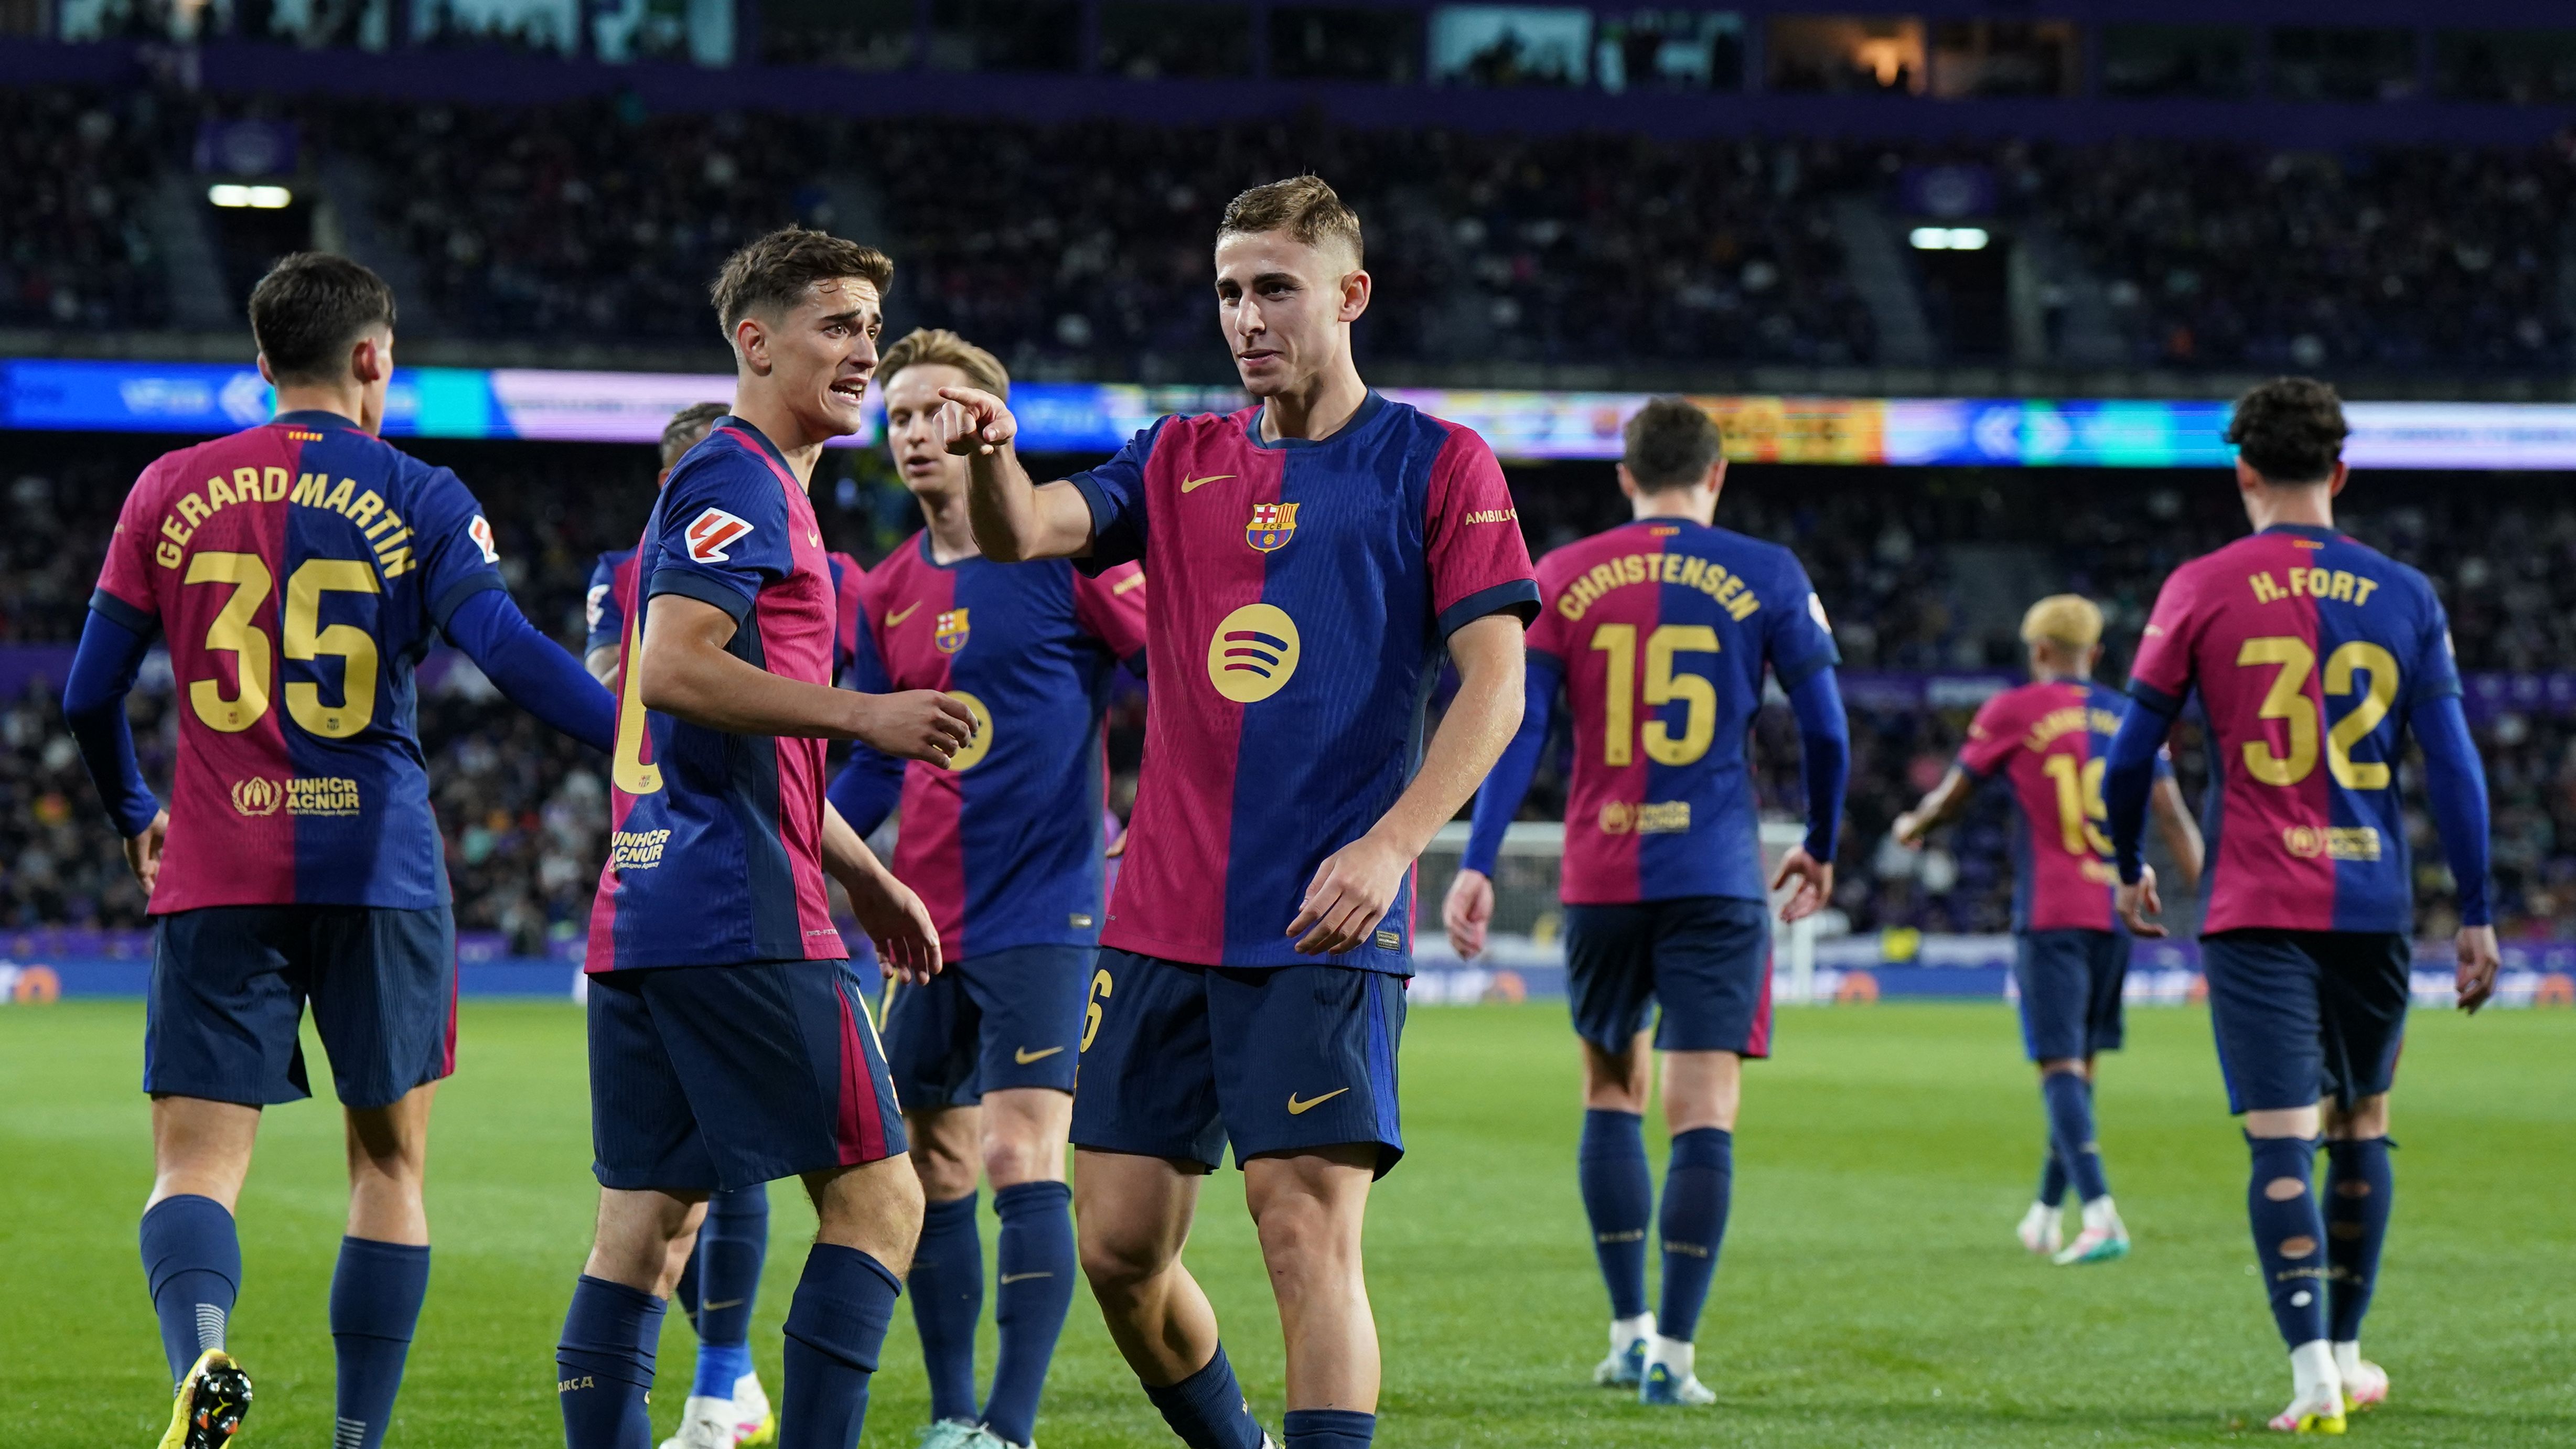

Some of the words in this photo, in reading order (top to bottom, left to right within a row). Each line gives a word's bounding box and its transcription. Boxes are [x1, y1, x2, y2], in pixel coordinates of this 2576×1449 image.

[156, 467, 288, 570] GERARD
[289, 473, 416, 579] MARTÍN
[1558, 553, 1761, 621] CHRISTENSEN
[2249, 567, 2378, 607] H.FORT
[184, 551, 381, 738] 35
[1591, 623, 1720, 766] 15
[2237, 636, 2399, 789] 32
[285, 793, 359, 809] ACNUR
[286, 777, 358, 793] UNHCR
[611, 829, 671, 847] UNHCR
